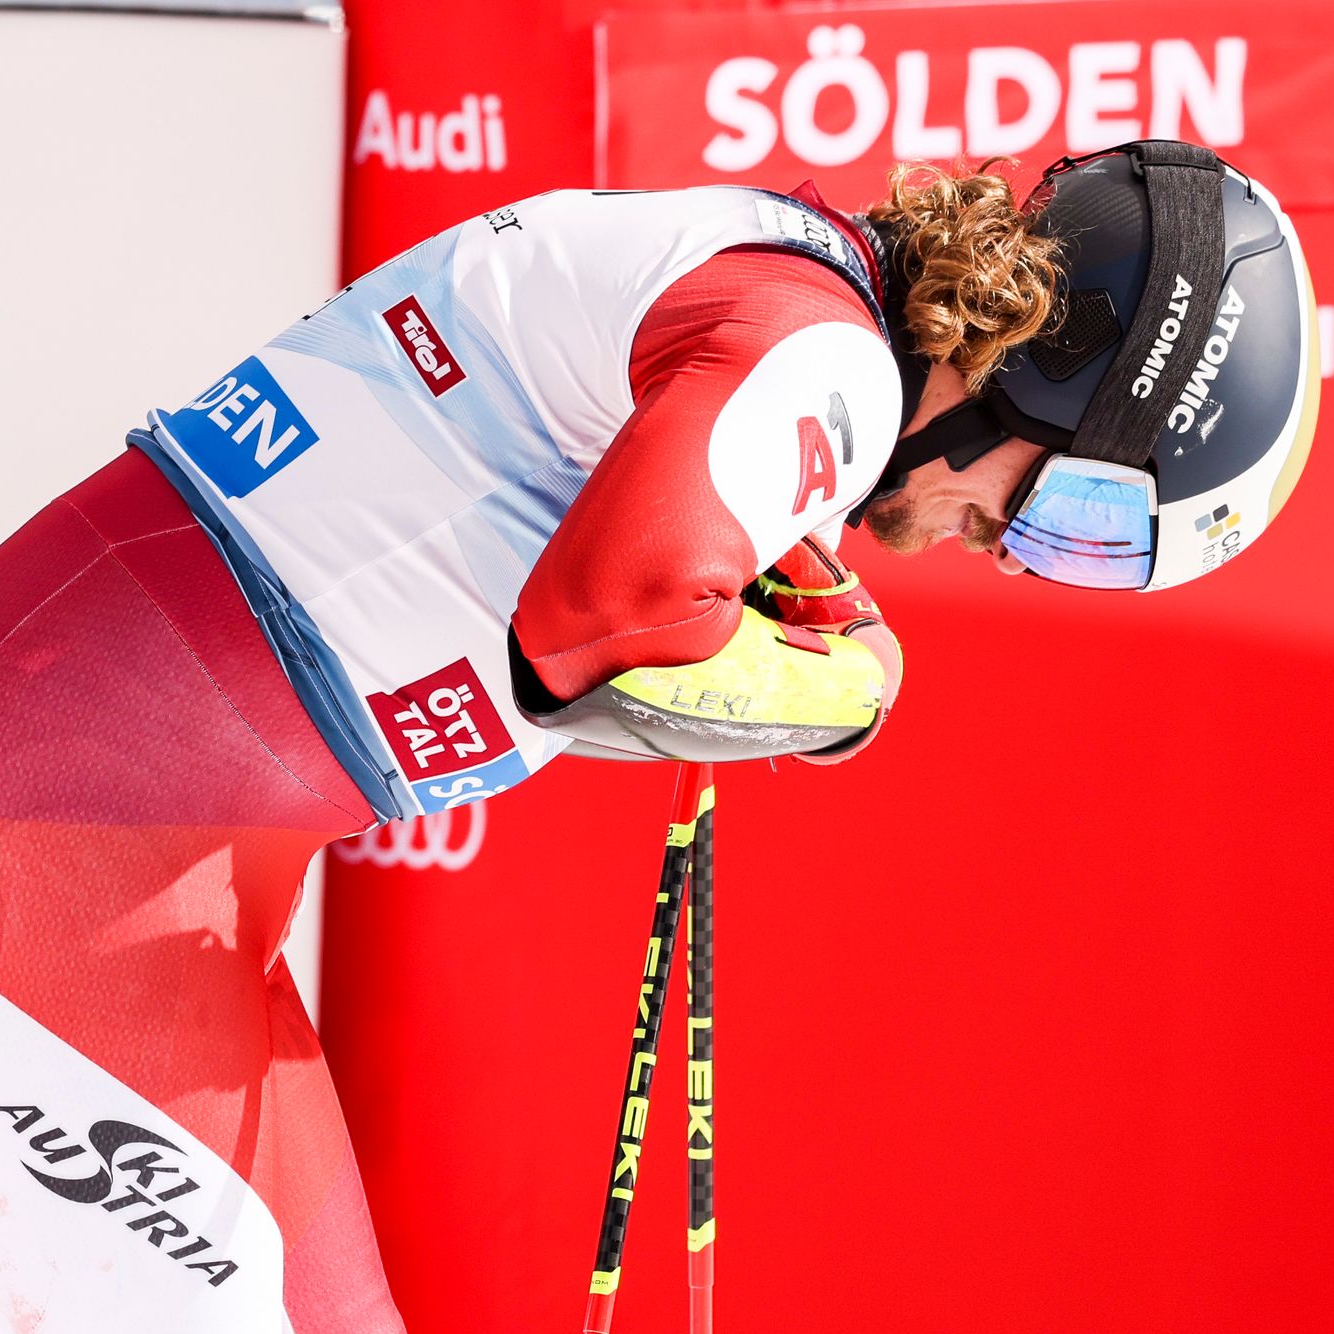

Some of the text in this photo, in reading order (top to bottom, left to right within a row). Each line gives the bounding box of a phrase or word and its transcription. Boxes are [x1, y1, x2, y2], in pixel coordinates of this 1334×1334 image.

[354, 91, 507, 172] Audi
[702, 24, 1248, 171] SÖLDEN
[401, 308, 452, 381] Tirol
[1131, 273, 1194, 400] ATOMIC
[1167, 284, 1247, 435] ATOMIC
[791, 391, 854, 516] A1
[393, 700, 446, 769] TAL
[427, 683, 488, 759] ÖTZ
[670, 684, 752, 719] LEKI
[611, 1050, 657, 1203] LEKI
[687, 1016, 713, 1160] LEKI
